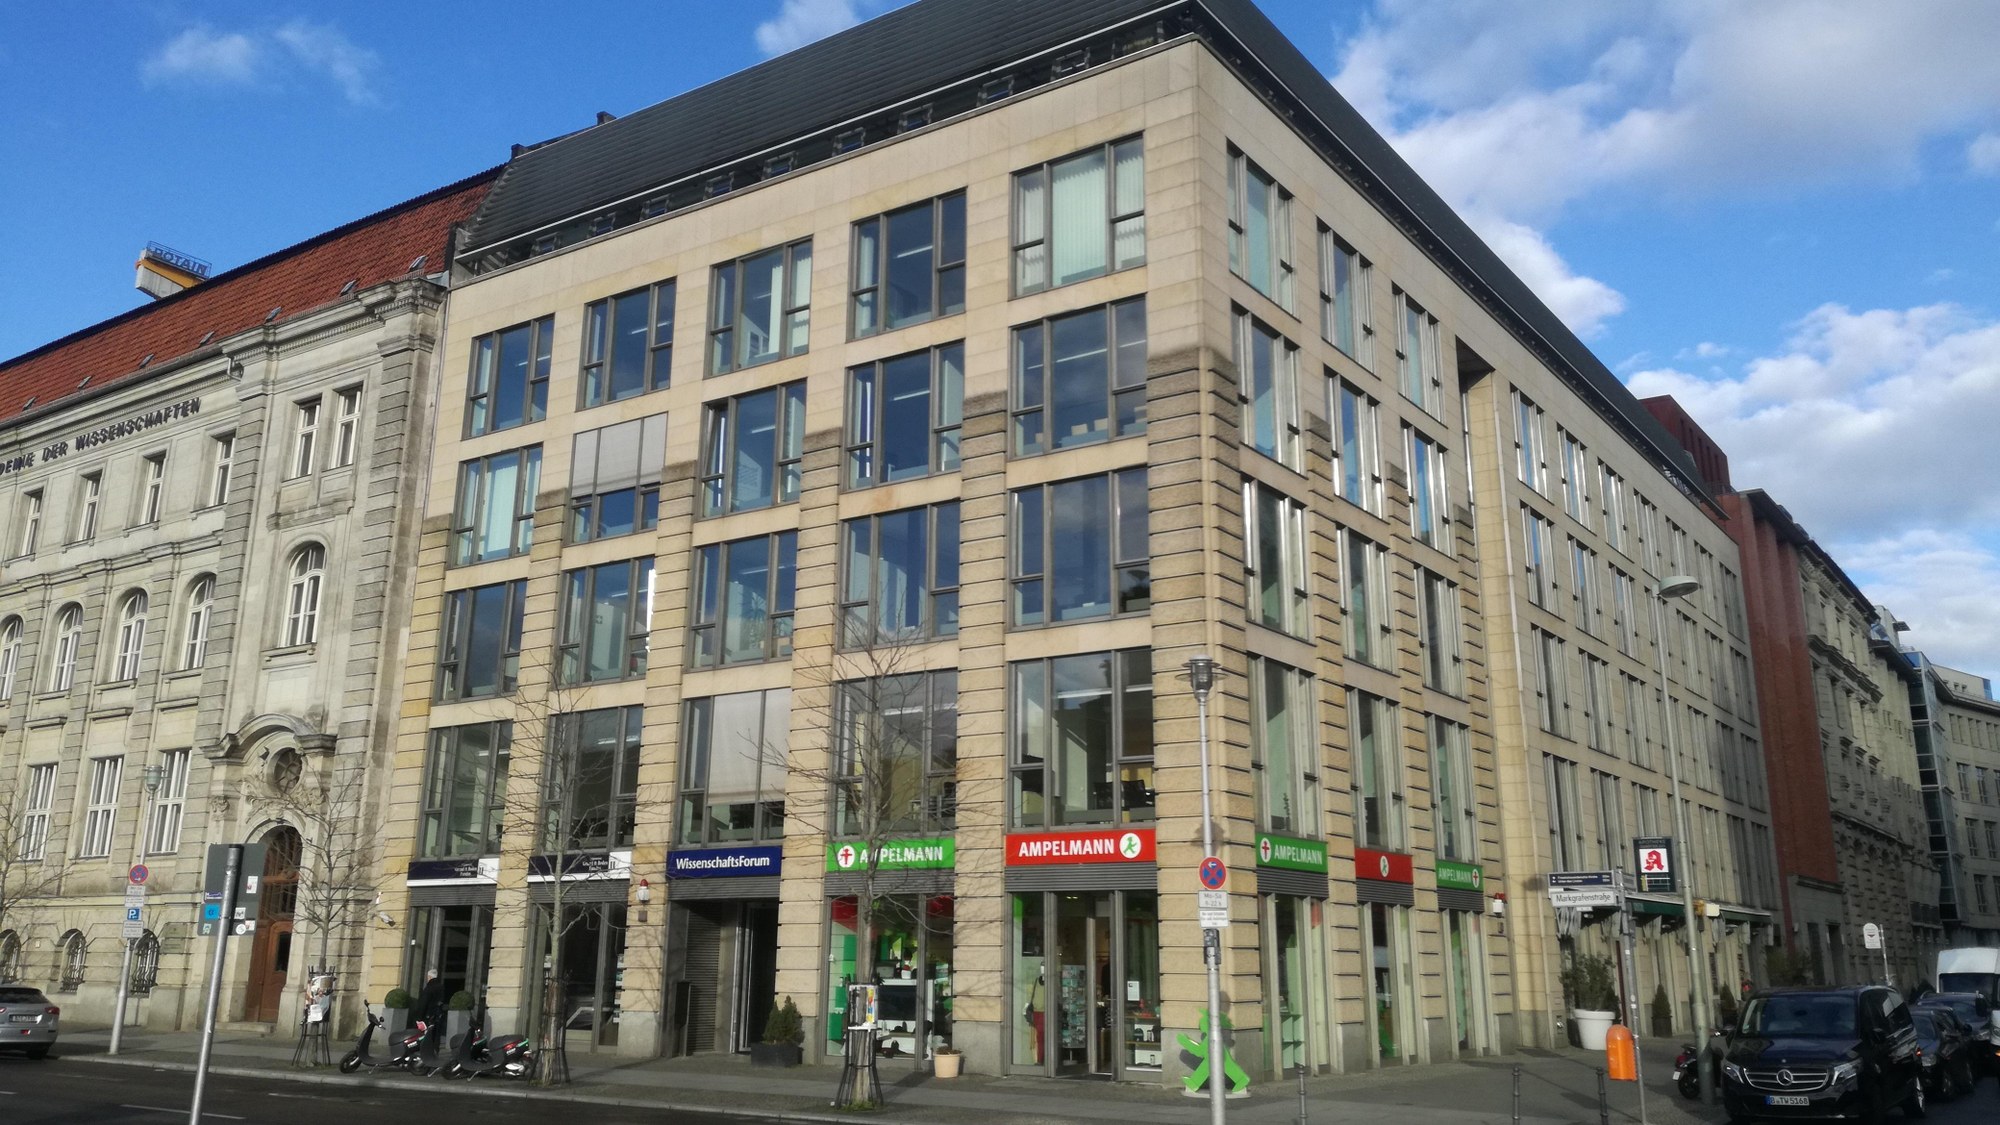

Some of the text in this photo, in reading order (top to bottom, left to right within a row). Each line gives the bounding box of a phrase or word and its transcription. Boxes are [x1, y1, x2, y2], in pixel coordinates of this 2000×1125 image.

[42, 441, 69, 462] DER
[76, 397, 201, 451] WISSENSCHAFTEN
[1019, 838, 1115, 857] AMPELMANN
[1274, 844, 1322, 865] AMPELMANN
[676, 855, 770, 870] WissenschaftsForum
[1438, 867, 1472, 883] AMPELMANN
[1556, 893, 1611, 904] Markgrafenstraße
[128, 909, 137, 919] P
[1790, 1096, 1808, 1105] 5168
